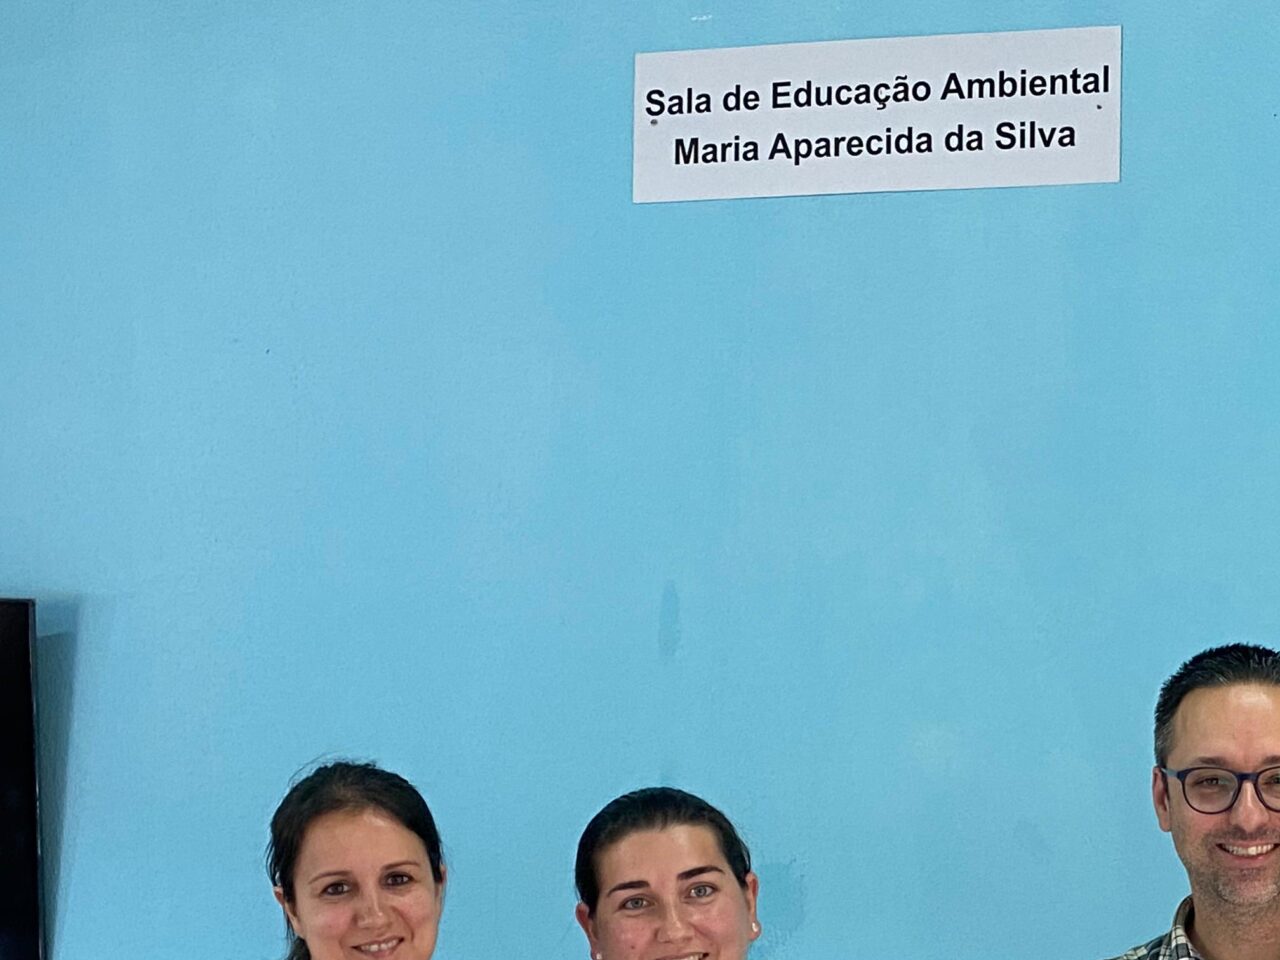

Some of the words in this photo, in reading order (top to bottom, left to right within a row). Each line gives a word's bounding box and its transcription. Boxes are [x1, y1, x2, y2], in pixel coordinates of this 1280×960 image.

[645, 88, 712, 117] Sala
[722, 85, 760, 111] de
[772, 75, 931, 111] Educação
[940, 65, 1110, 101] Ambiental
[674, 136, 759, 165] Maria
[768, 127, 933, 166] Aparecida
[944, 124, 983, 152] da
[995, 121, 1076, 150] Silva
